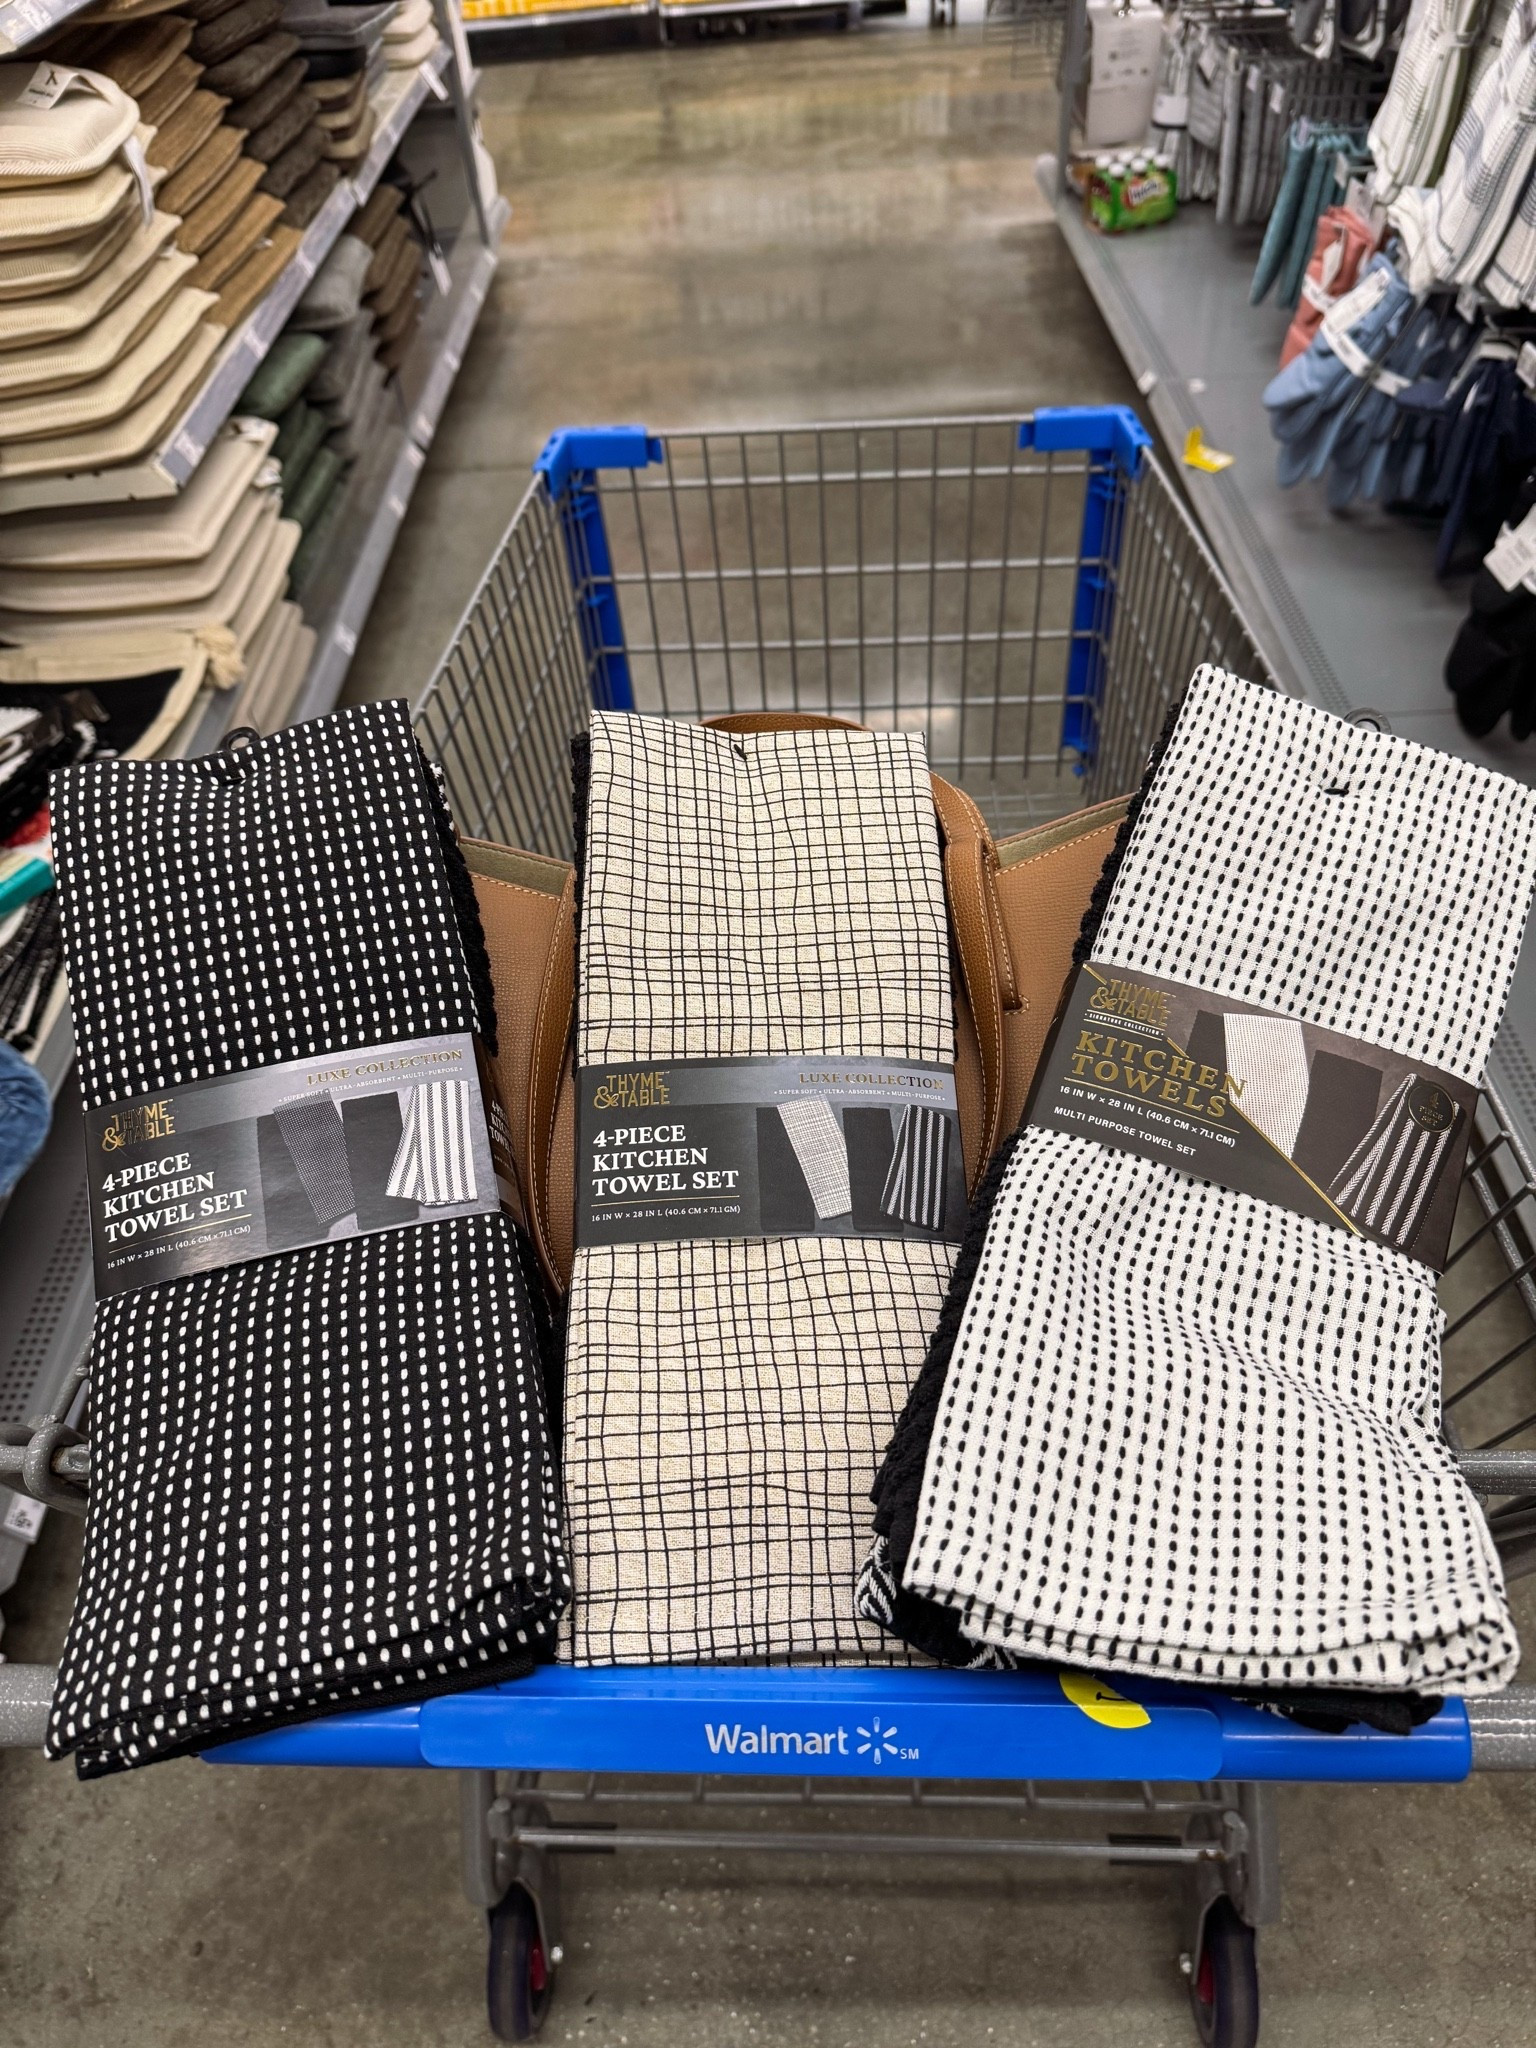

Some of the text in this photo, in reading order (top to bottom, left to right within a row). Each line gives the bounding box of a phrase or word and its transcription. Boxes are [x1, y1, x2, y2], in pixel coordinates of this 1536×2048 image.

[1110, 978, 1168, 1009] THYME
[1089, 1013, 1160, 1035] SIGNATURE COLLECTION
[1117, 998, 1170, 1027] TABLE
[307, 1049, 463, 1086] LUXE COLLECTION
[1076, 1030, 1247, 1099] KITCHEN
[606, 1072, 665, 1092] THYME
[619, 1088, 670, 1107] TABLE
[800, 1073, 943, 1090] LUXE COLLECTION
[1071, 1053, 1227, 1118] TOWELS
[111, 1100, 169, 1132] THYME
[1053, 1106, 1196, 1156] MULTI PURPOSE TOWEL SET
[1060, 1085, 1070, 1094] 16
[1072, 1088, 1084, 1098] IN
[1087, 1092, 1097, 1101] W
[1108, 1098, 1120, 1108] 28
[1123, 1102, 1135, 1113] IN
[1137, 1106, 1143, 1115] L
[1146, 1109, 1171, 1124] (40.6
[1173, 1119, 1190, 1131] CM
[1199, 1127, 1214, 1141] 71.1
[1215, 1133, 1236, 1148] CM)
[593, 1124, 686, 1148] 4-PIECE
[102, 1152, 191, 1192] 4-PIECE
[592, 1147, 708, 1172] KITCHEN
[103, 1171, 214, 1218] KITCHEN
[592, 1170, 739, 1196] TOWEL SET
[105, 1189, 247, 1243] TOWEL SET
[665, 1208, 686, 1217] (40.6
[688, 1207, 701, 1215] CM
[117, 1258, 125, 1266] IN
[144, 1249, 154, 1258] 28
[156, 1245, 166, 1254] IN
[175, 1238, 196, 1251] (40.6
[198, 1234, 211, 1243] CM
[234, 1225, 251, 1234] CM)
[704, 1723, 919, 1760] Walmart SM
